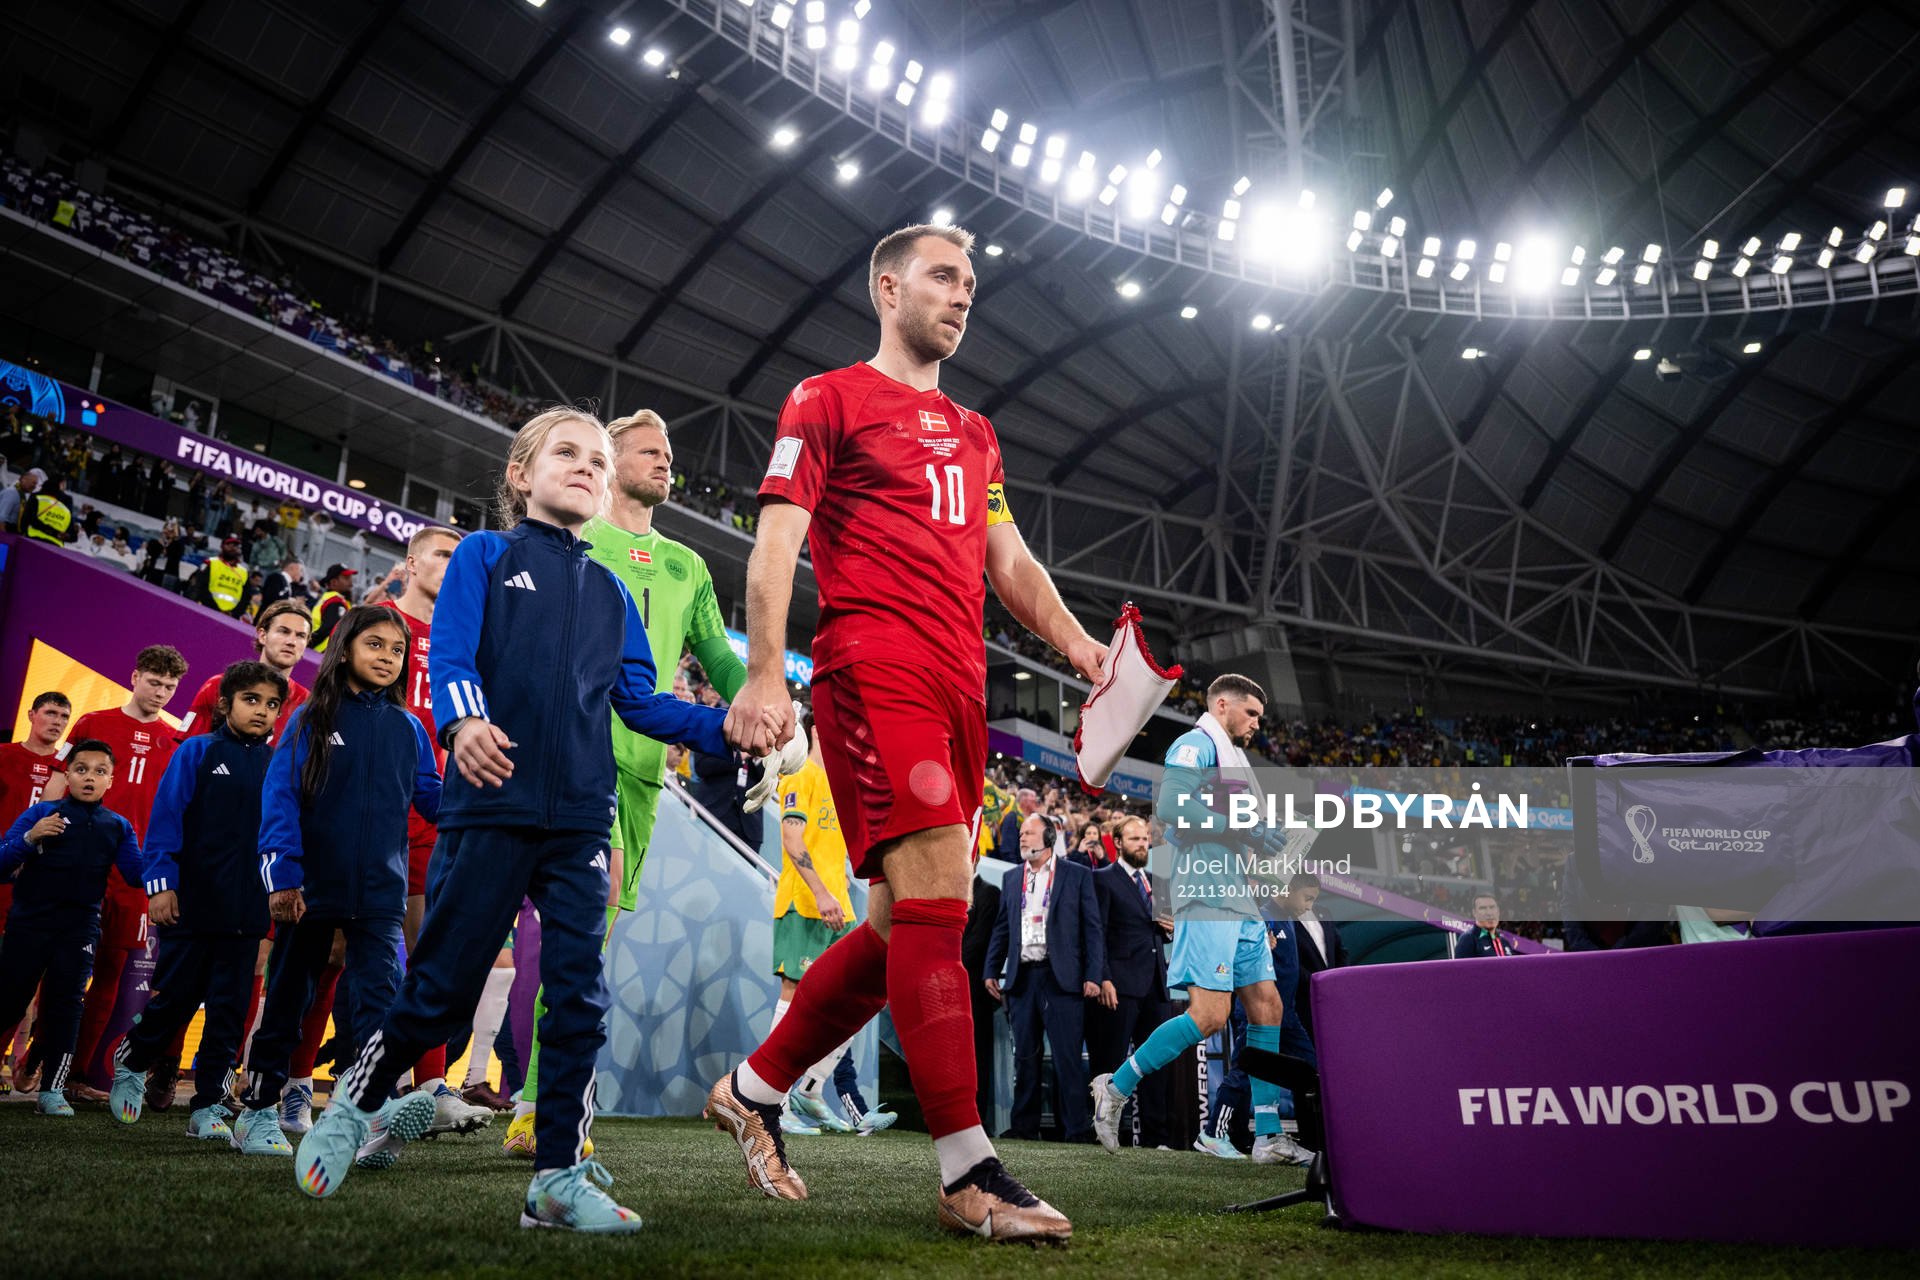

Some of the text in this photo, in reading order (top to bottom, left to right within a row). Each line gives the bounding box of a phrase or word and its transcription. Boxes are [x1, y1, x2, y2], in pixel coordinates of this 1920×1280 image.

[177, 436, 232, 475] FIFA
[235, 456, 320, 503] WORLD
[322, 490, 367, 520] CUP
[925, 464, 966, 525] 10
[643, 588, 650, 630] 1
[128, 756, 146, 784] 11
[29, 786, 42, 808] 6
[1662, 828, 1771, 840] FIFA WORLD CUP
[1458, 1081, 1910, 1125] FIFA WORLD CUP
